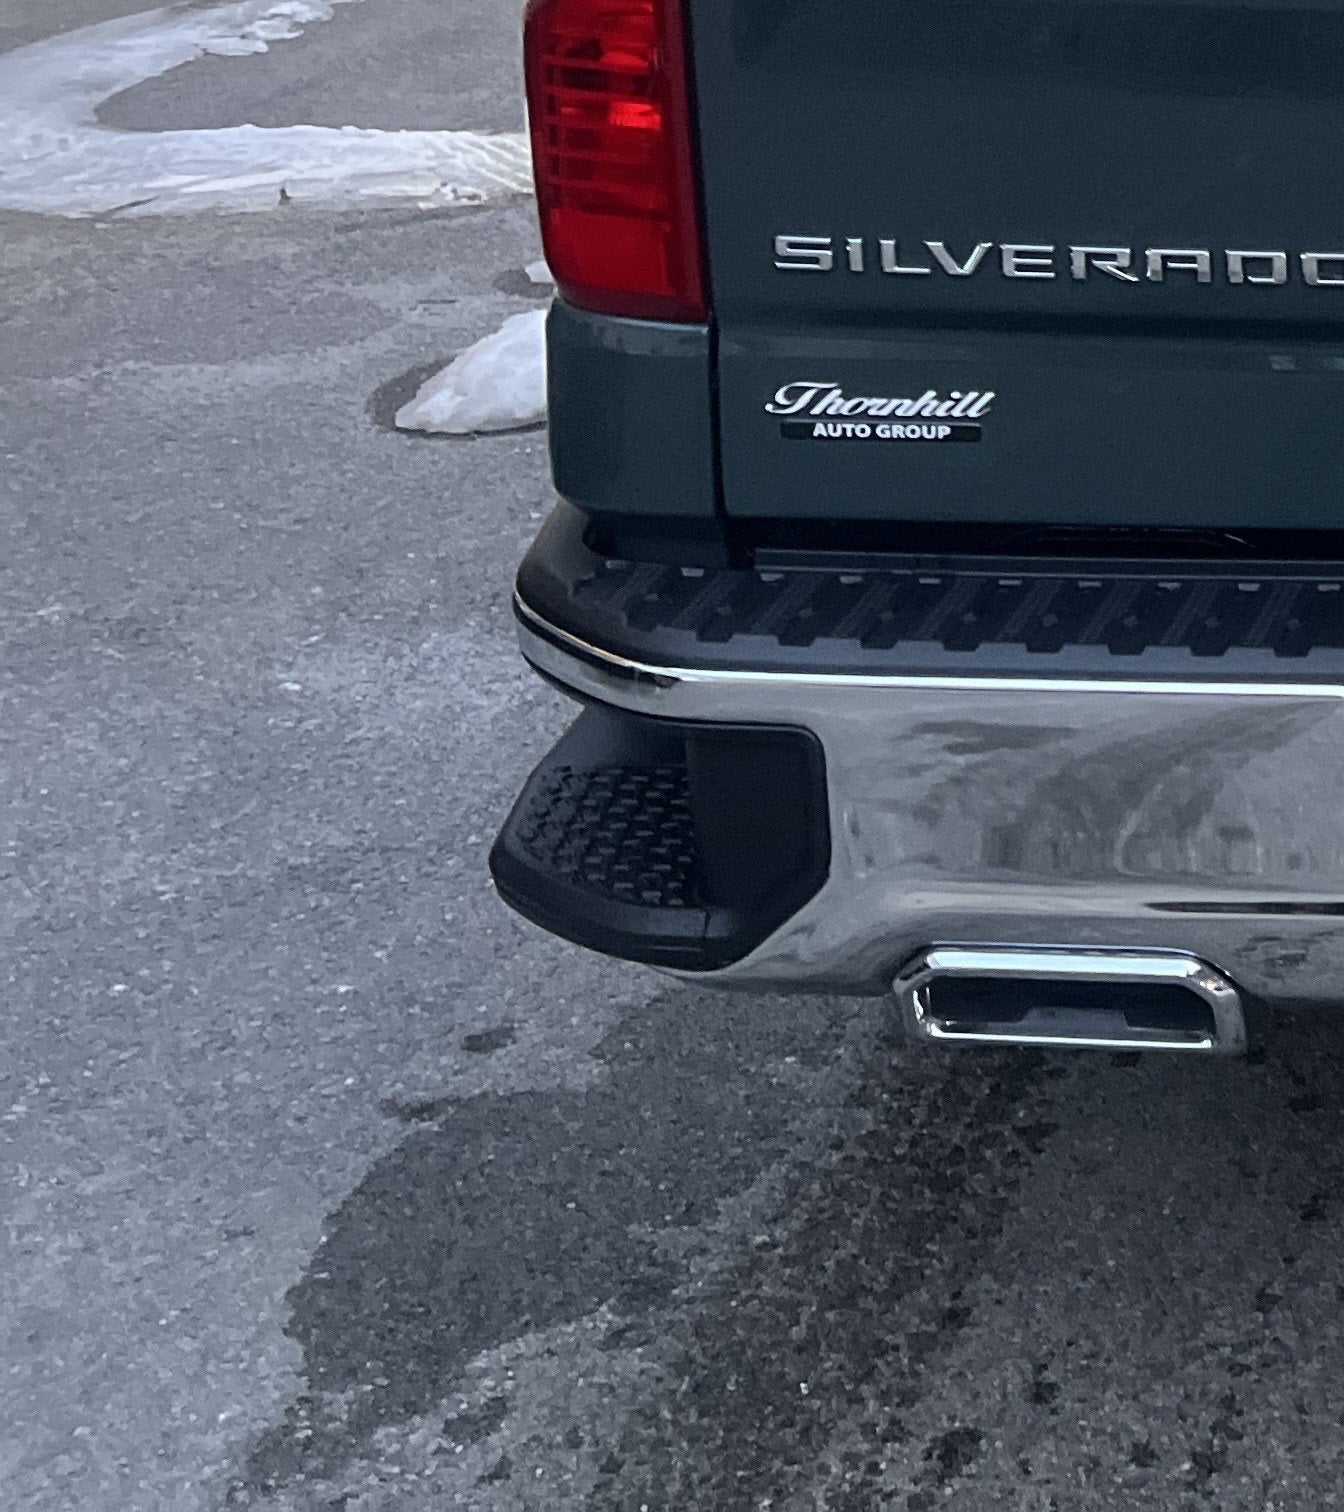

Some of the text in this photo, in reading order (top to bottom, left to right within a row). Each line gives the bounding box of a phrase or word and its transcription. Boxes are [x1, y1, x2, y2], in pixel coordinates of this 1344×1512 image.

[764, 381, 996, 418] Thornhill
[812, 422, 951, 440] AUTO GROUP
